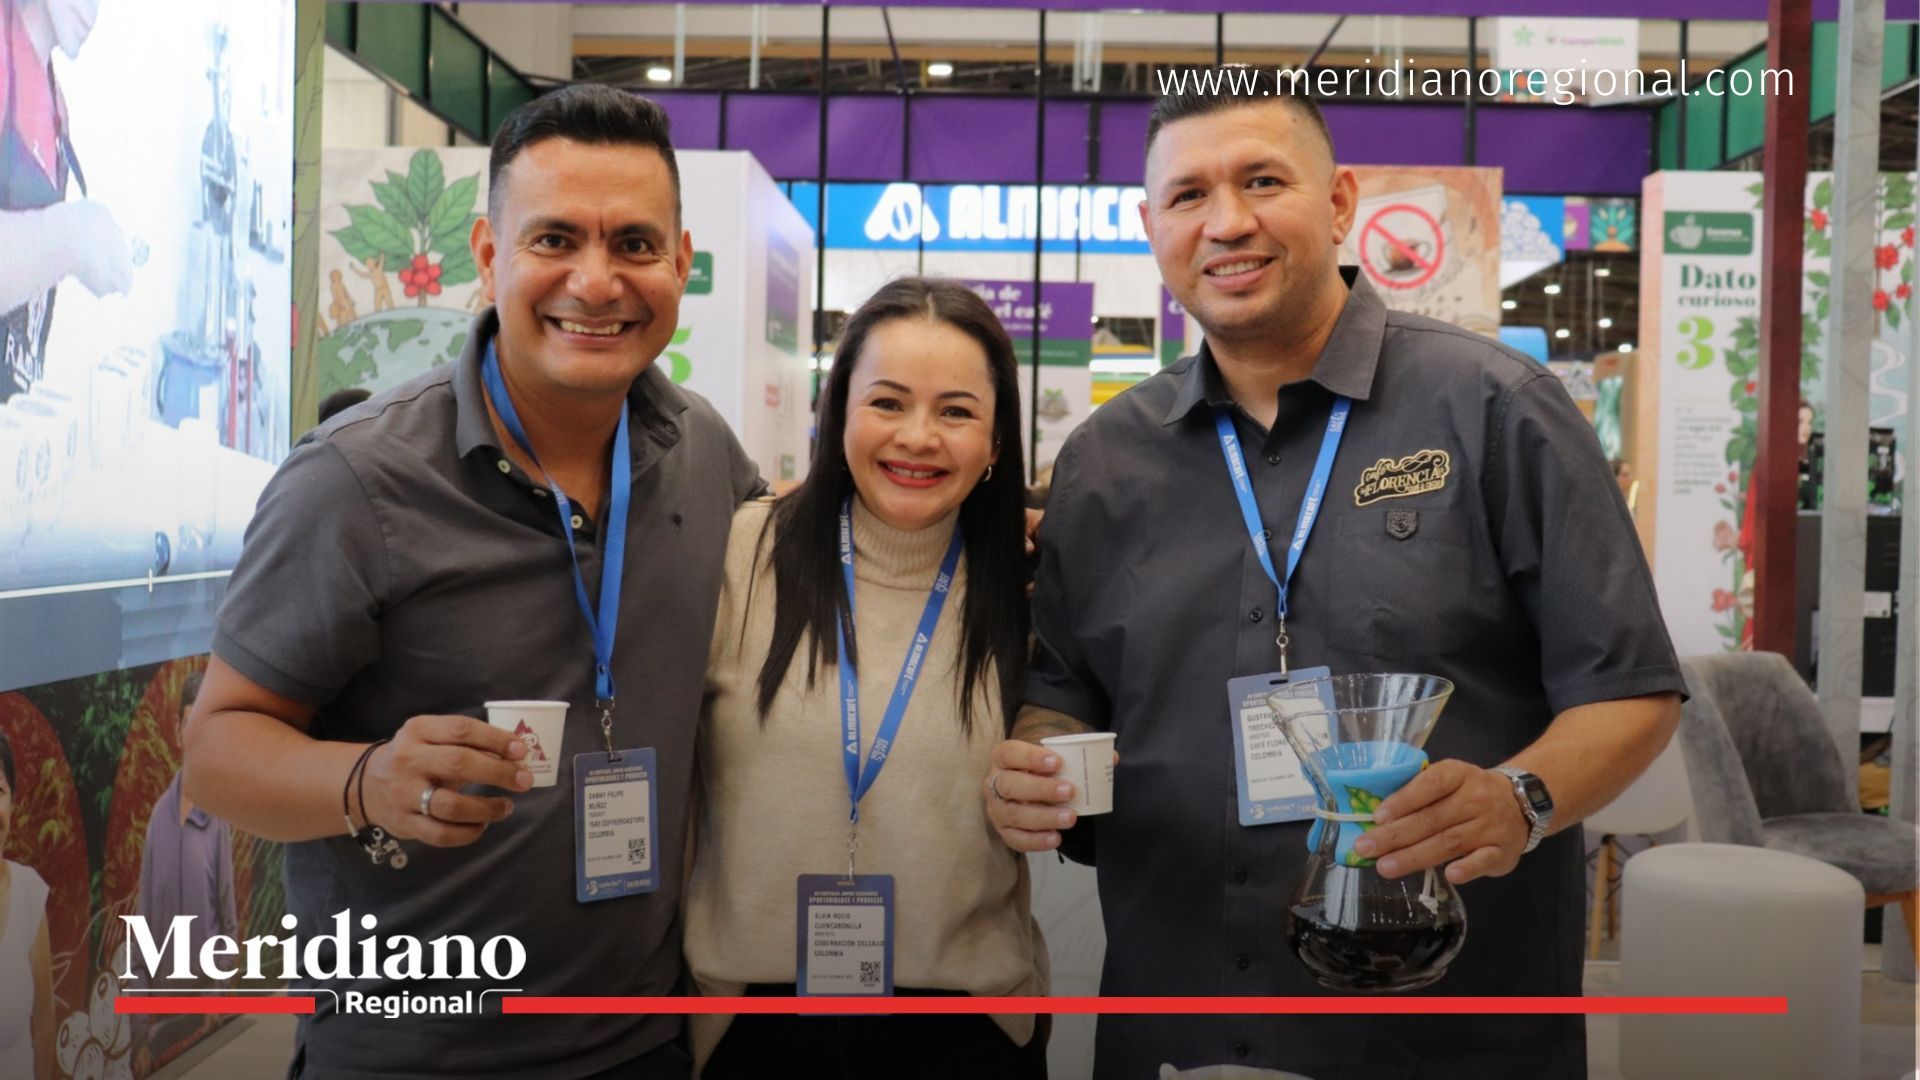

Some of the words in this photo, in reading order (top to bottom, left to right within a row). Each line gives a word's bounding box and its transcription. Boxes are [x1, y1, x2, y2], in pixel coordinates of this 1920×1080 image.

[949, 185, 1149, 241] ALMACA
[1680, 264, 1757, 289] Dato
[1678, 291, 1757, 307] curioso
[1676, 314, 1716, 371] 3
[1364, 466, 1443, 497] FLORENCIA
[1247, 712, 1275, 722] GUSTAV
[1266, 738, 1288, 748] FLORE
[1250, 750, 1283, 761] COLOMBIA
